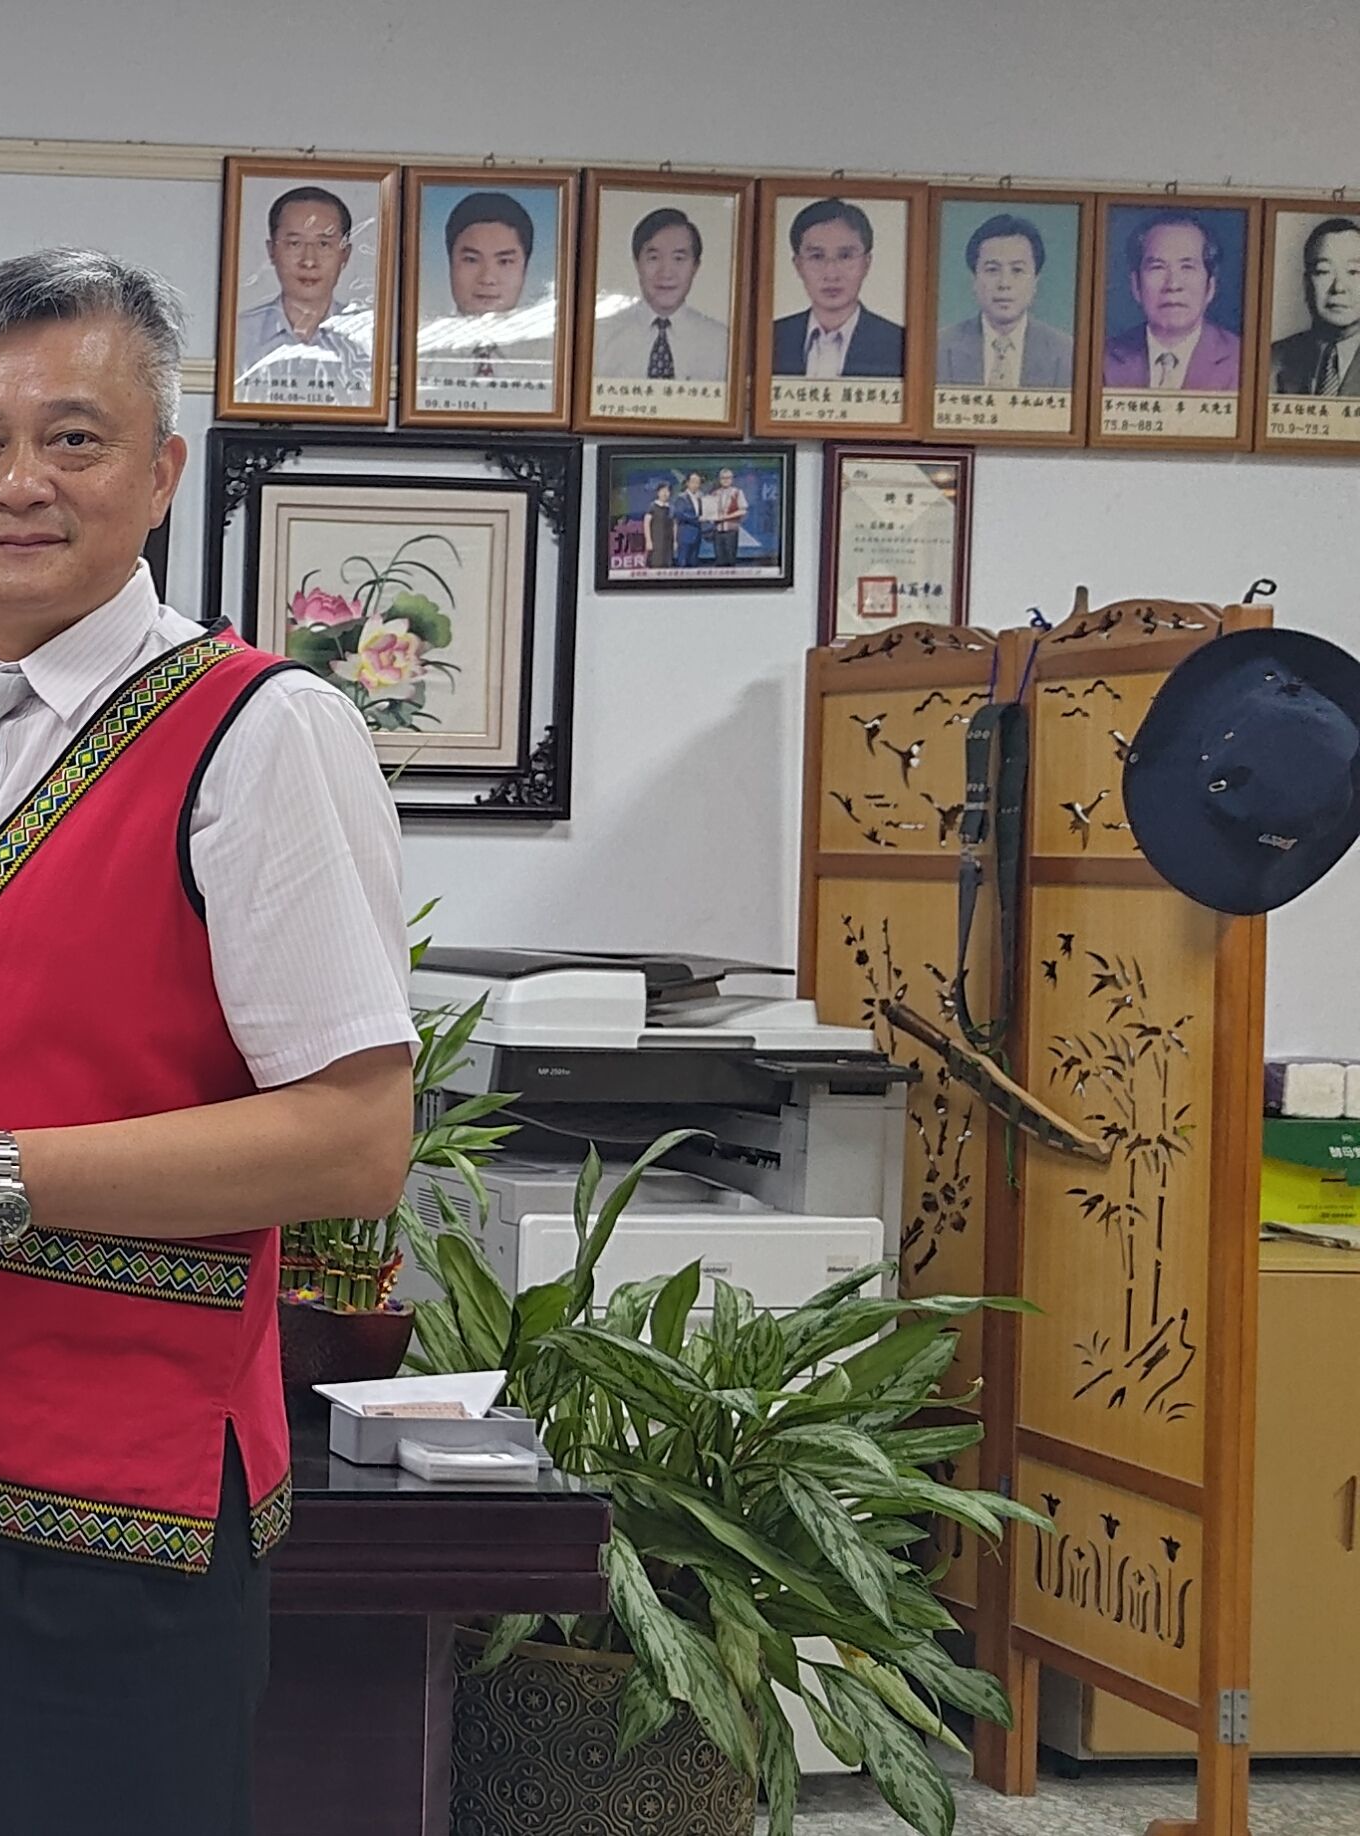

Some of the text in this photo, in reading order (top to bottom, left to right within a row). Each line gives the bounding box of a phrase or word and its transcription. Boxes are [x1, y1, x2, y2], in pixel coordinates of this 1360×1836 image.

[1104, 399, 1161, 413] 第六任校長
